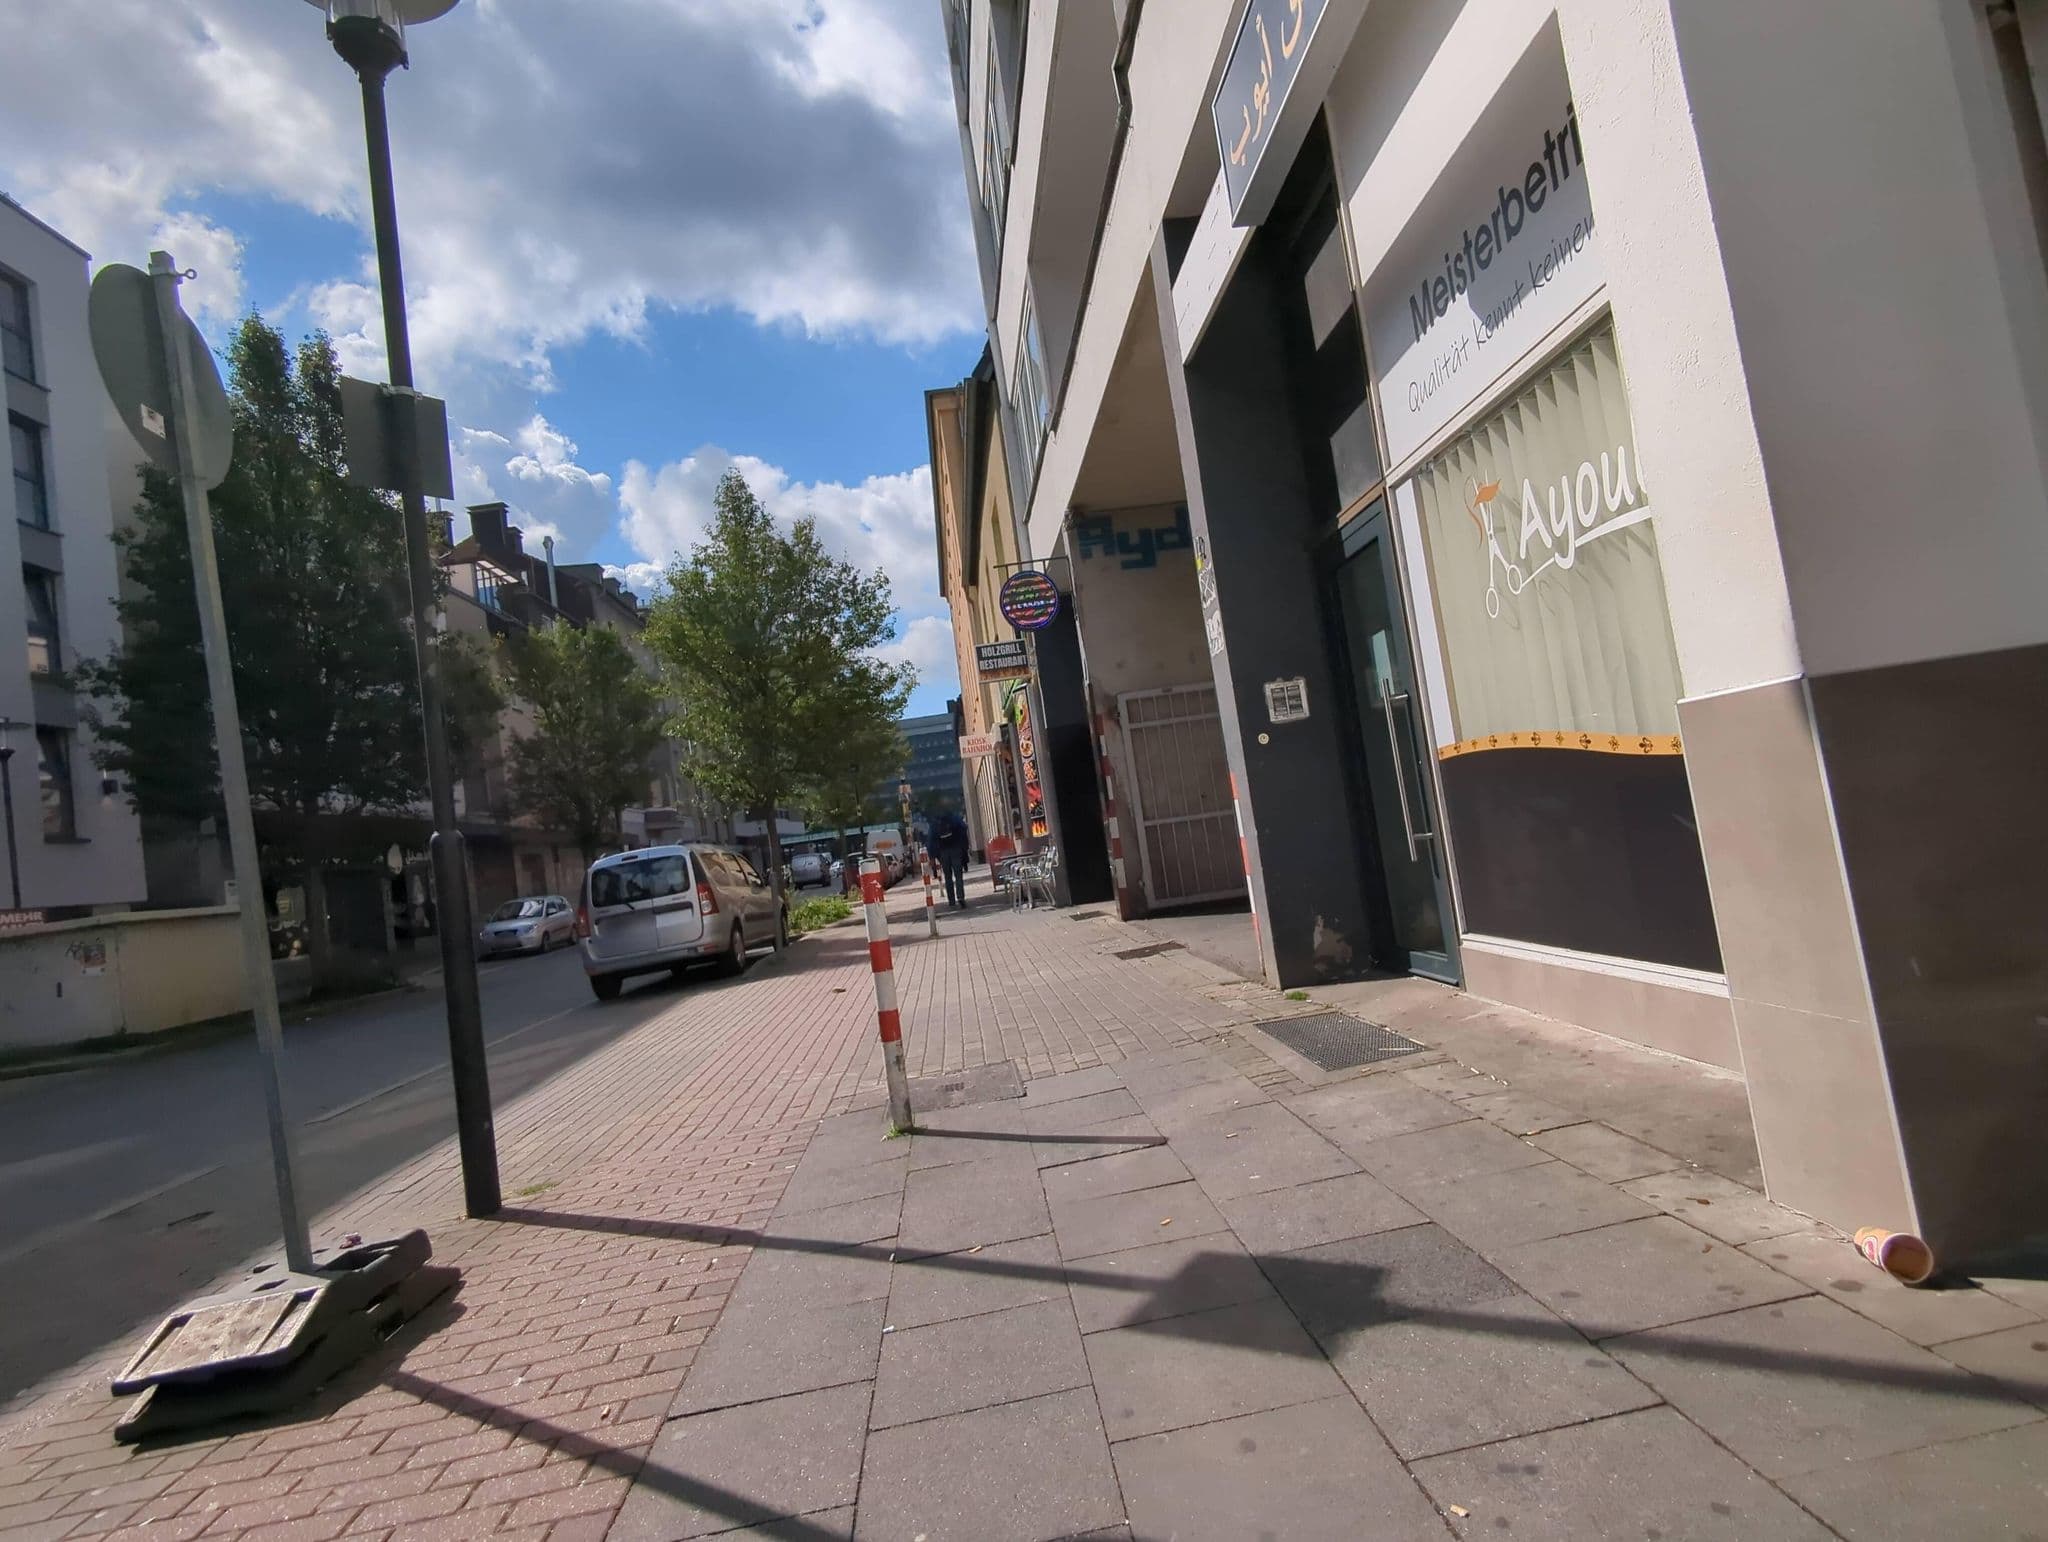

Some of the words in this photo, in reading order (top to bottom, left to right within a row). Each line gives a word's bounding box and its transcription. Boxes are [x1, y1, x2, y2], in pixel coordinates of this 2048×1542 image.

[1408, 334, 1469, 413] Qualität
[1473, 280, 1524, 351] kennt
[1519, 446, 1647, 570] Ayou
[979, 654, 1027, 670] RESTAURANT
[981, 643, 1022, 658] HOLZGRILL
